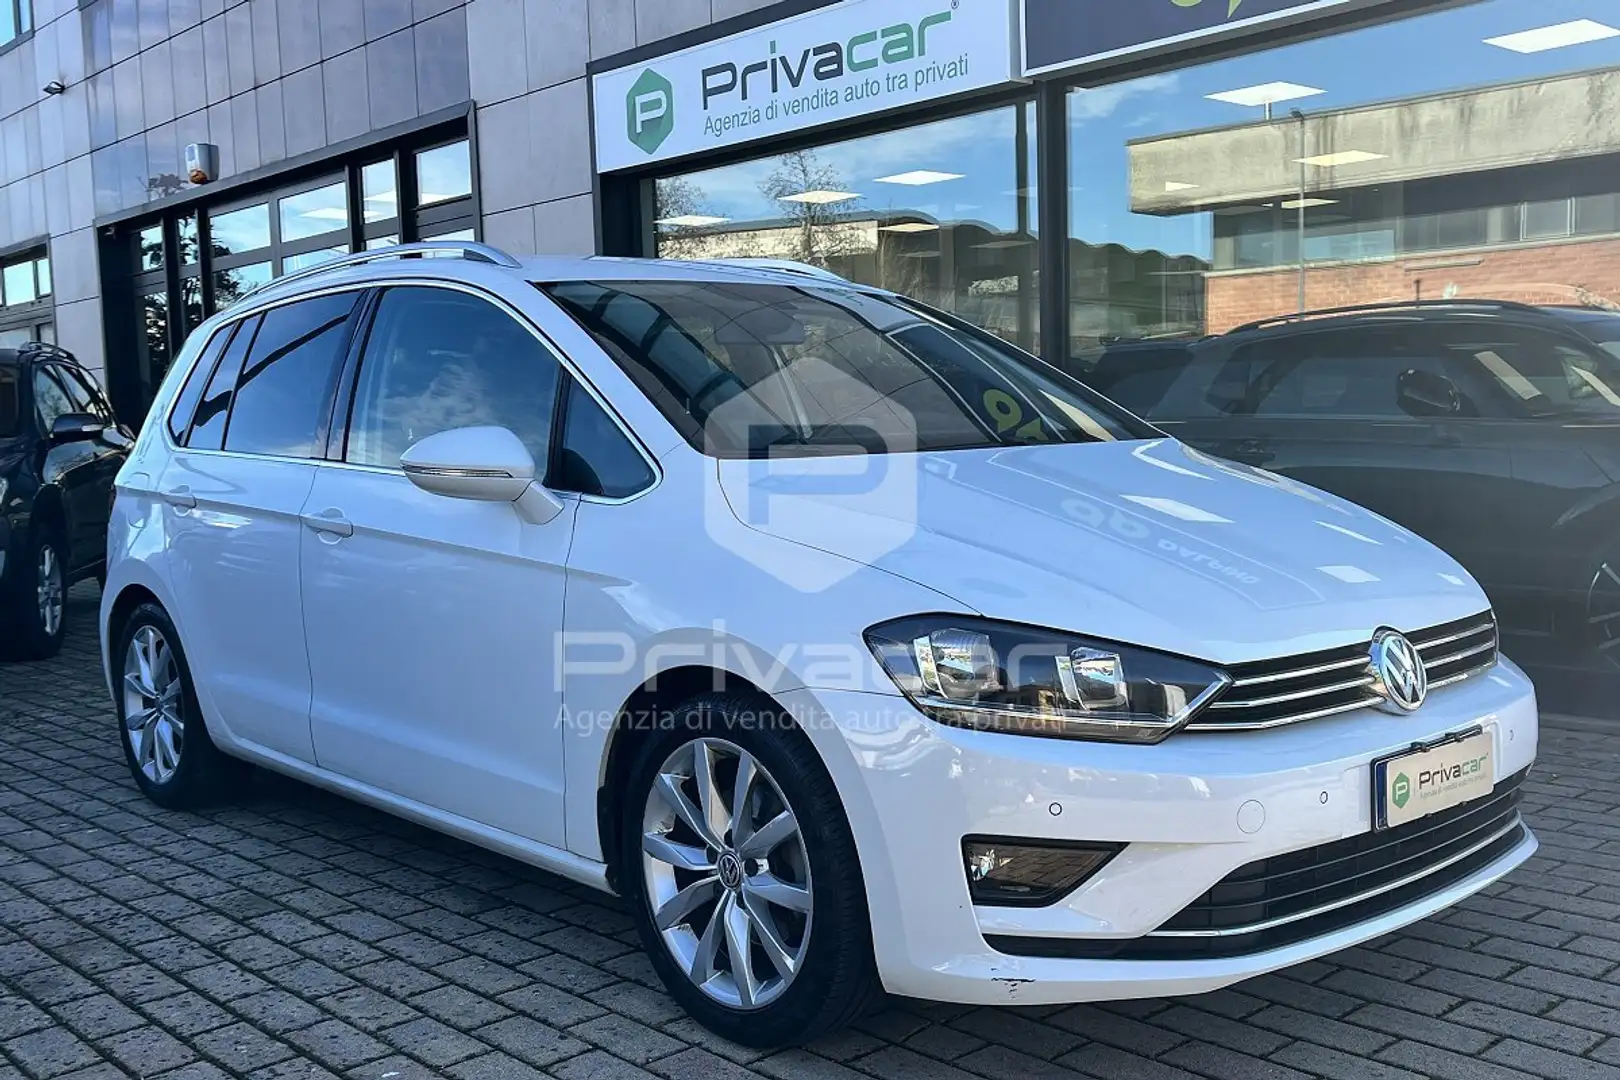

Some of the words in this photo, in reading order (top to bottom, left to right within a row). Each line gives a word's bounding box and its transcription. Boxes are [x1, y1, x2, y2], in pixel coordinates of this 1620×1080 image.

[702, 11, 952, 110] Privacar
[703, 106, 761, 137] Agenzia
[765, 101, 778, 120] di
[782, 89, 839, 117] vendita
[844, 78, 881, 103] auto
[886, 72, 909, 93] tra
[914, 53, 969, 92] privati
[1418, 755, 1488, 790] Privacar
